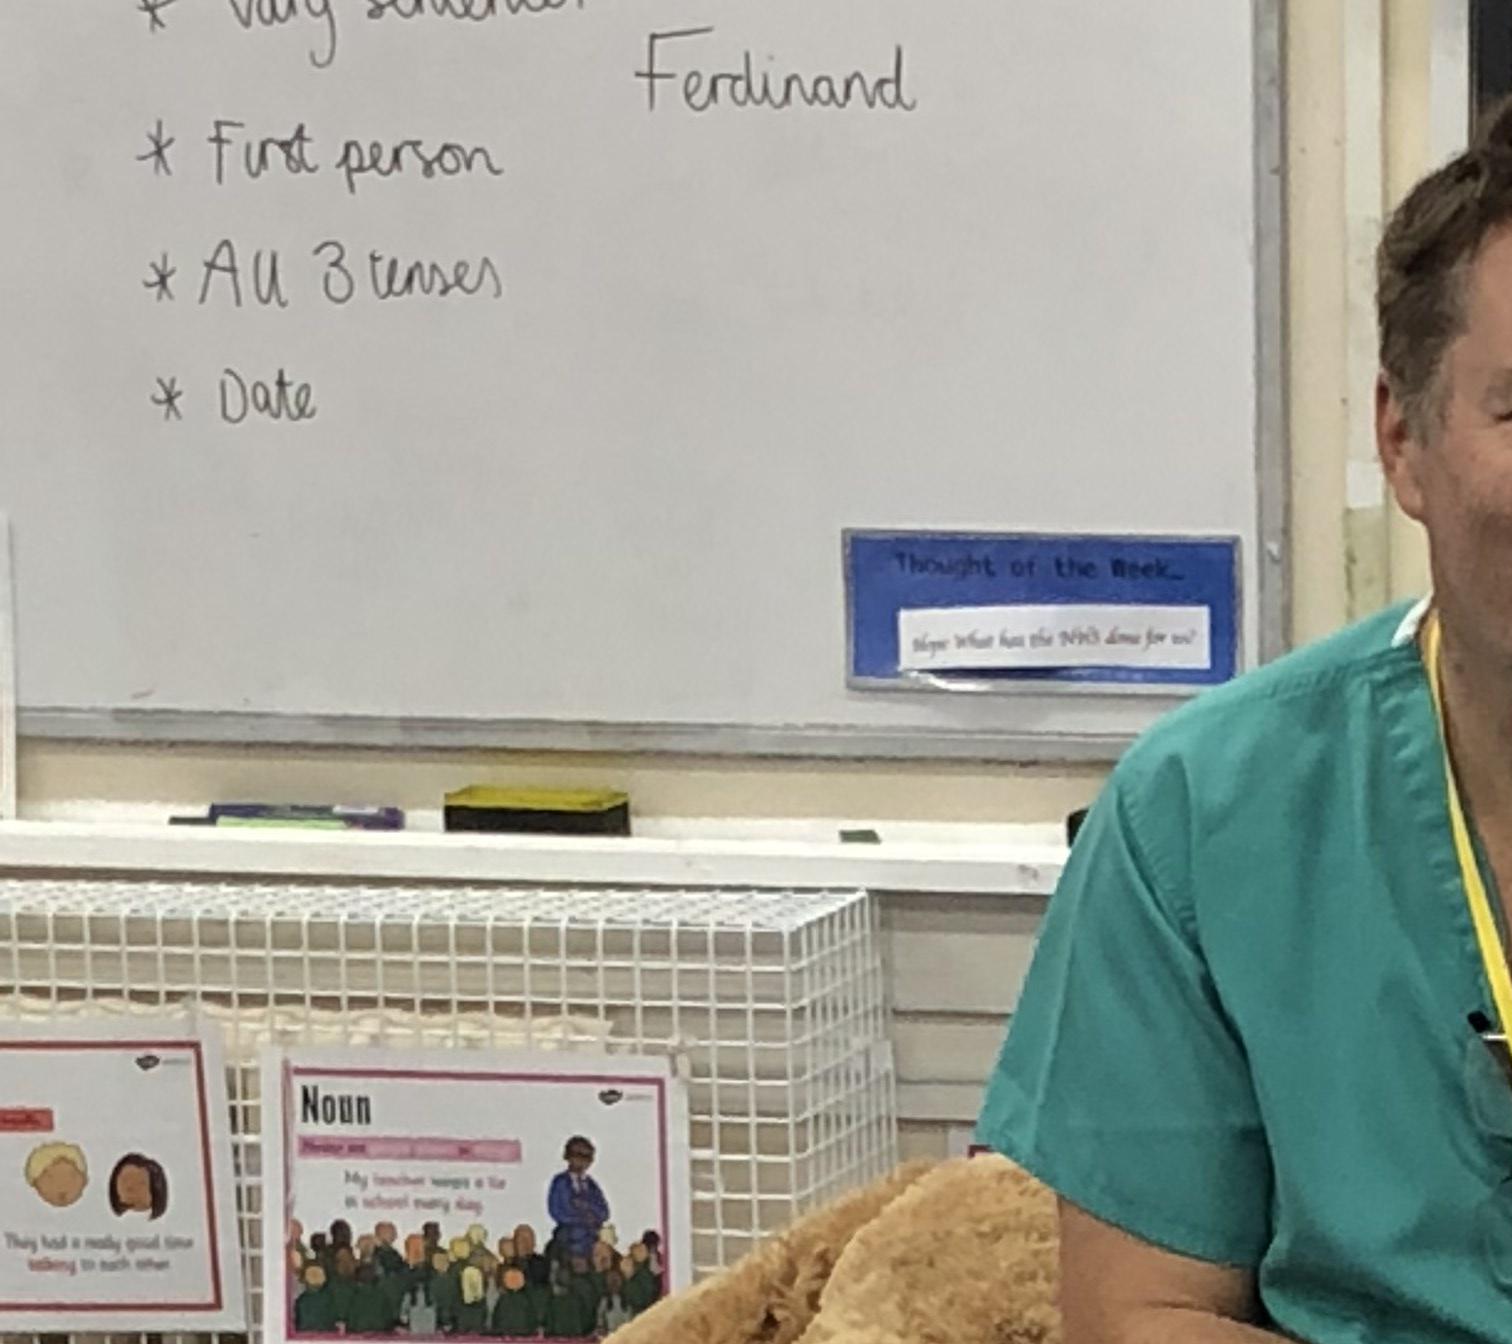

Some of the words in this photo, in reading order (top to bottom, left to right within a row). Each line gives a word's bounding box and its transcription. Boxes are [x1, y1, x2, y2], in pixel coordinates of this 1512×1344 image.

[634, 25, 918, 112] Ferdinand
[207, 119, 319, 185] First
[335, 137, 504, 195] person
[198, 238, 289, 307] All
[312, 239, 354, 304] 3
[368, 248, 502, 300] tenses
[218, 366, 317, 424] Date
[895, 552, 996, 580] Thought
[1010, 556, 1037, 579] of
[1054, 555, 1098, 579] the
[301, 1085, 373, 1126] Noun
